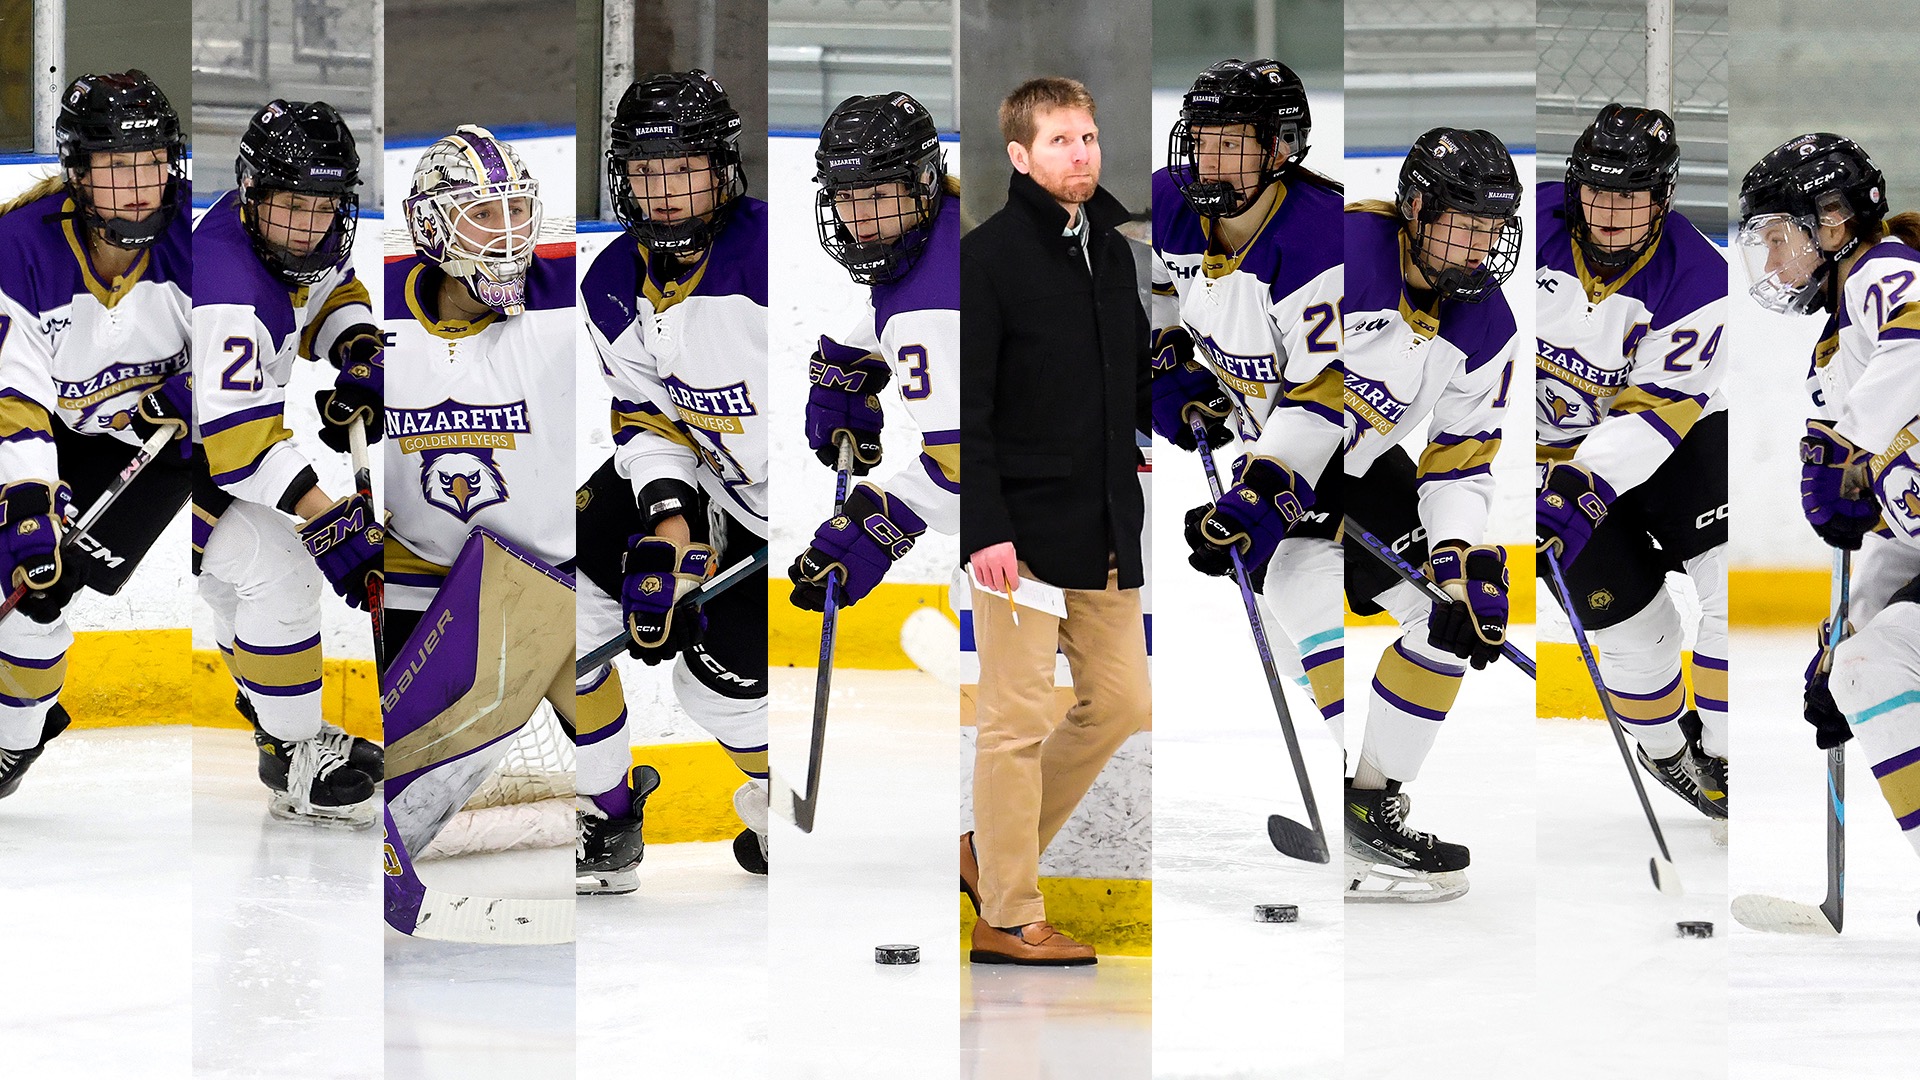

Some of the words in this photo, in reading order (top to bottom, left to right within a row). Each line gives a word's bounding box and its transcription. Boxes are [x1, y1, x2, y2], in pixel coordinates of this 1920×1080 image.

[1192, 94, 1220, 104] NAZARETH
[1278, 106, 1299, 115] CCM
[121, 118, 159, 130] CCM
[728, 117, 741, 128] CCM
[635, 125, 673, 137] NAZARETH
[240, 141, 255, 157] CCM
[921, 136, 938, 150] CCM
[829, 157, 861, 168] NAZARETH
[1590, 163, 1624, 175] CCM
[309, 167, 343, 177] NAZARETH
[1412, 169, 1430, 187] CCM
[1803, 171, 1835, 190] CCM
[1191, 196, 1220, 204] CCM
[1487, 191, 1515, 200] NAZARETH
[654, 238, 691, 248] CCM
[1834, 236, 1859, 262] CCM
[853, 258, 885, 270] CCM
[1663, 323, 1724, 372] 24
[220, 335, 264, 392] 2
[897, 343, 933, 402] 3
[1572, 376, 1613, 397] FLYERS
[64, 384, 122, 410] GOLDEN
[147, 393, 164, 417] CCM
[665, 384, 752, 414] ARETH
[1208, 397, 1227, 409] CC
[384, 404, 527, 436] NAZARETH
[691, 415, 735, 432] FLYERS
[1357, 403, 1391, 434] FLYERS
[404, 433, 459, 451] GOLDEN
[461, 432, 509, 448] FLYERS
[1884, 433, 1911, 462] FLYERS
[60, 491, 72, 502] CCM
[1207, 518, 1231, 537] CCM
[1361, 531, 1422, 580] CCM
[1432, 556, 1453, 565] CCM
[28, 563, 55, 578] CCM
[384, 608, 454, 714] BAUER
